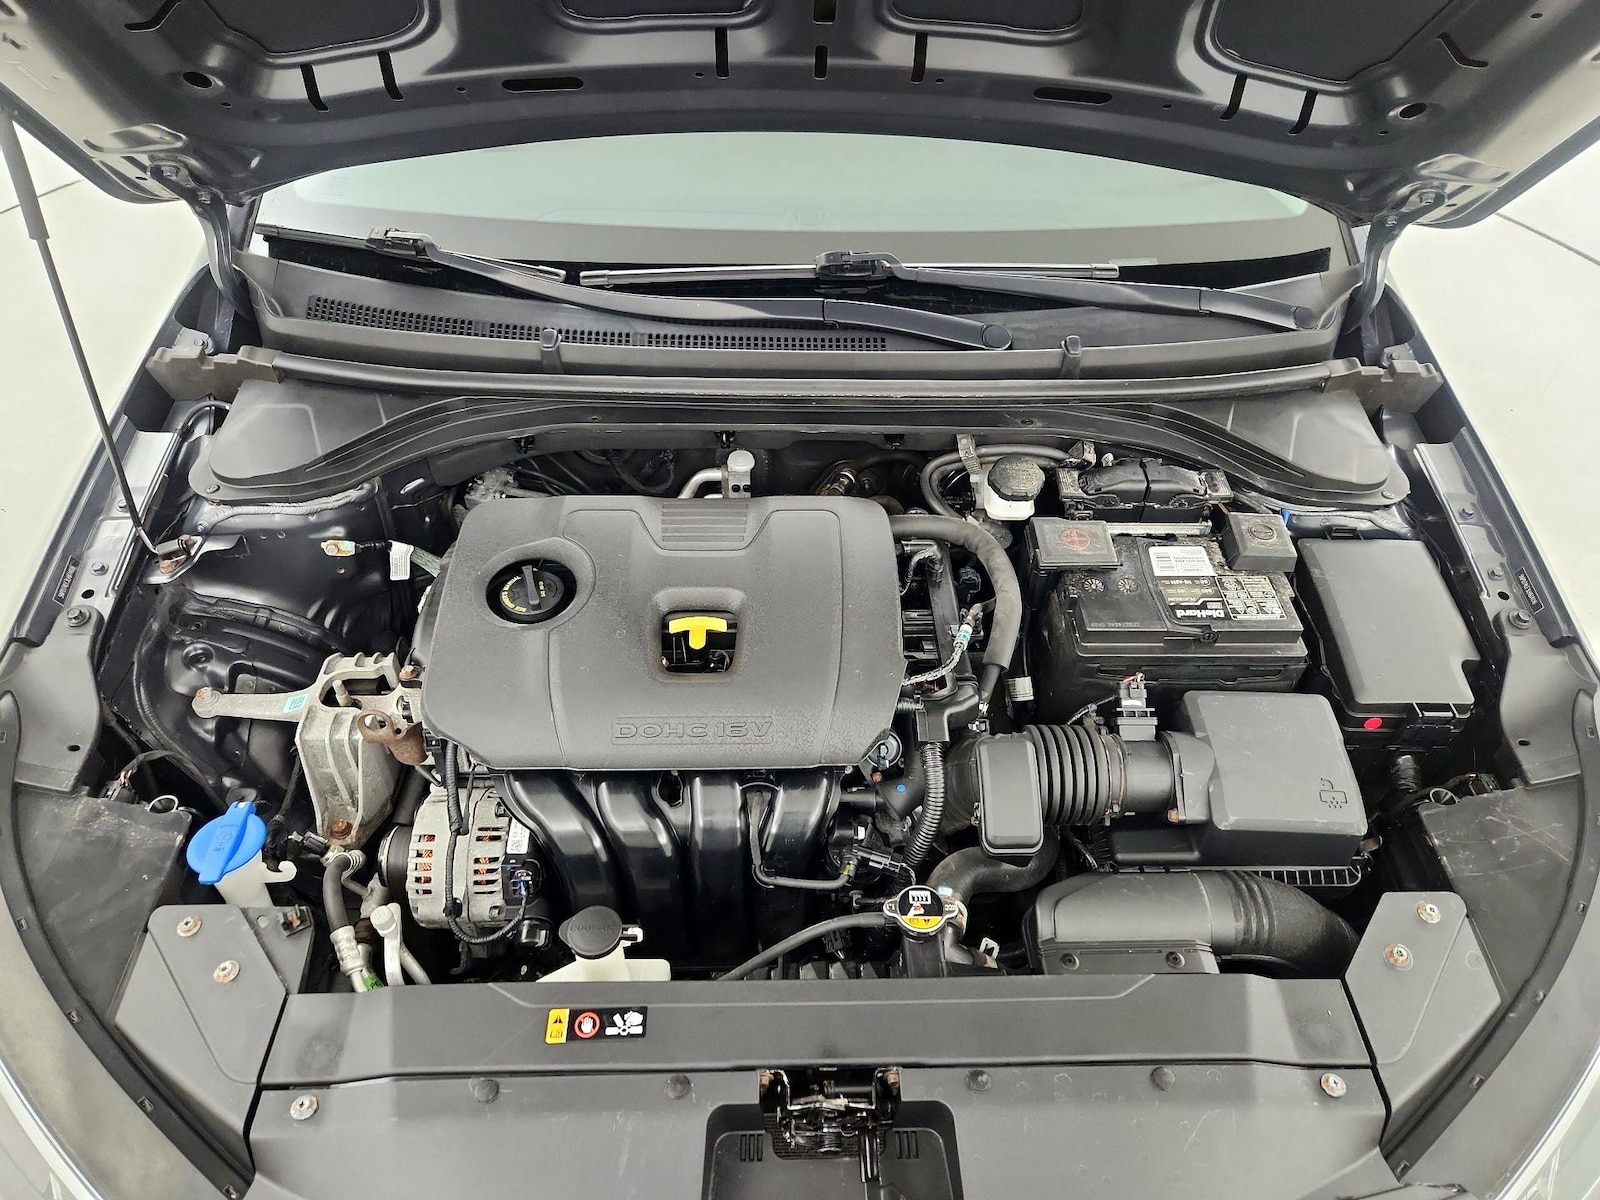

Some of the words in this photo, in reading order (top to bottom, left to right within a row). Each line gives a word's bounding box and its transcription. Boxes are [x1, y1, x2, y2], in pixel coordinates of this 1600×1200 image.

[1175, 609, 1225, 618] DieHard
[614, 722, 708, 739] DOHC
[717, 721, 773, 738] 16V
